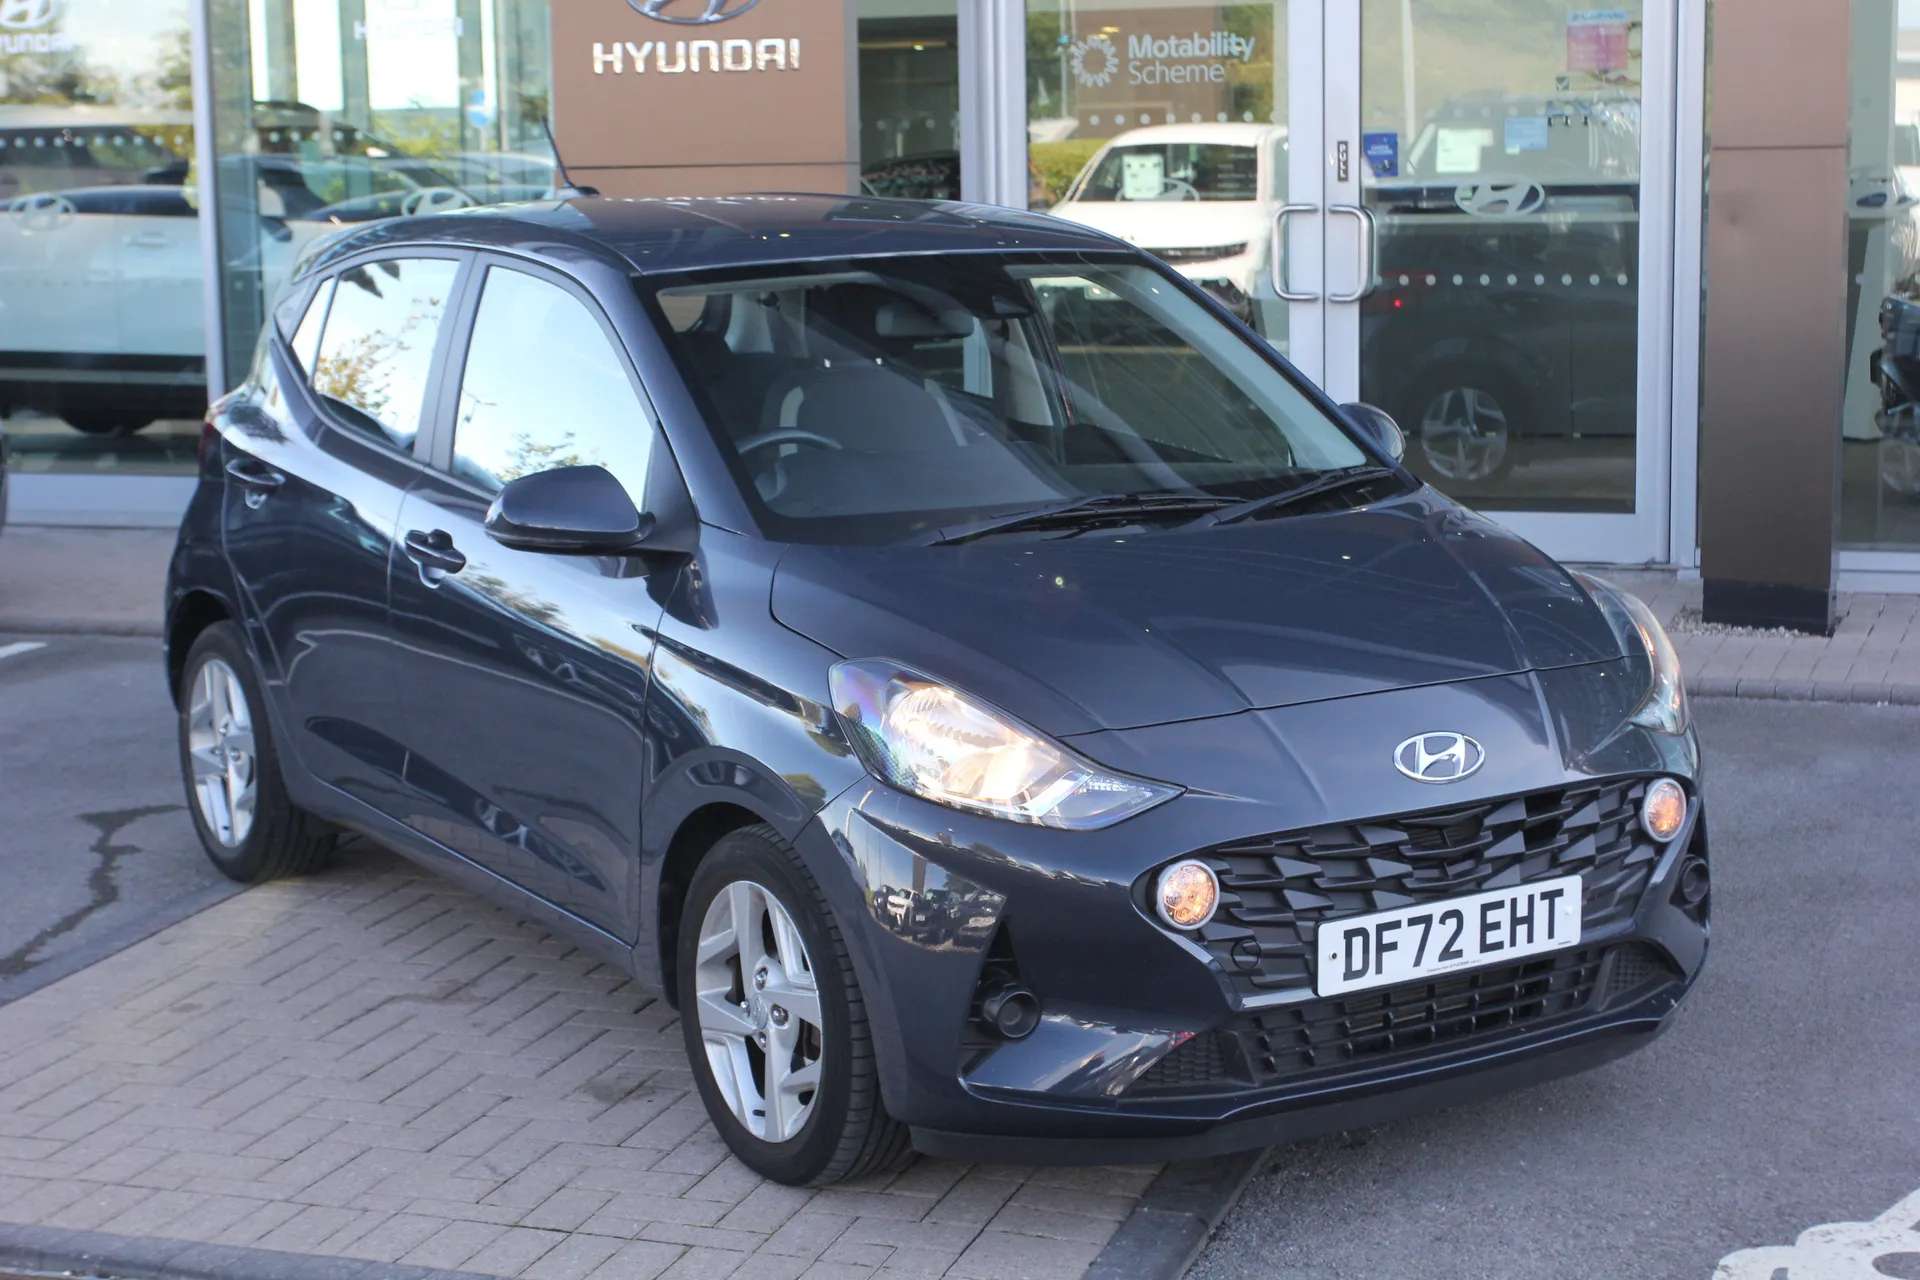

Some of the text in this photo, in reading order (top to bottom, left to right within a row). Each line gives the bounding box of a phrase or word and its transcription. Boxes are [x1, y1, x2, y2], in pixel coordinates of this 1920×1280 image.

[592, 38, 800, 74] HYUNDAI
[1128, 31, 1256, 62] Motability
[1128, 60, 1225, 85] Scheme
[1343, 888, 1565, 982] DF72 EHT
